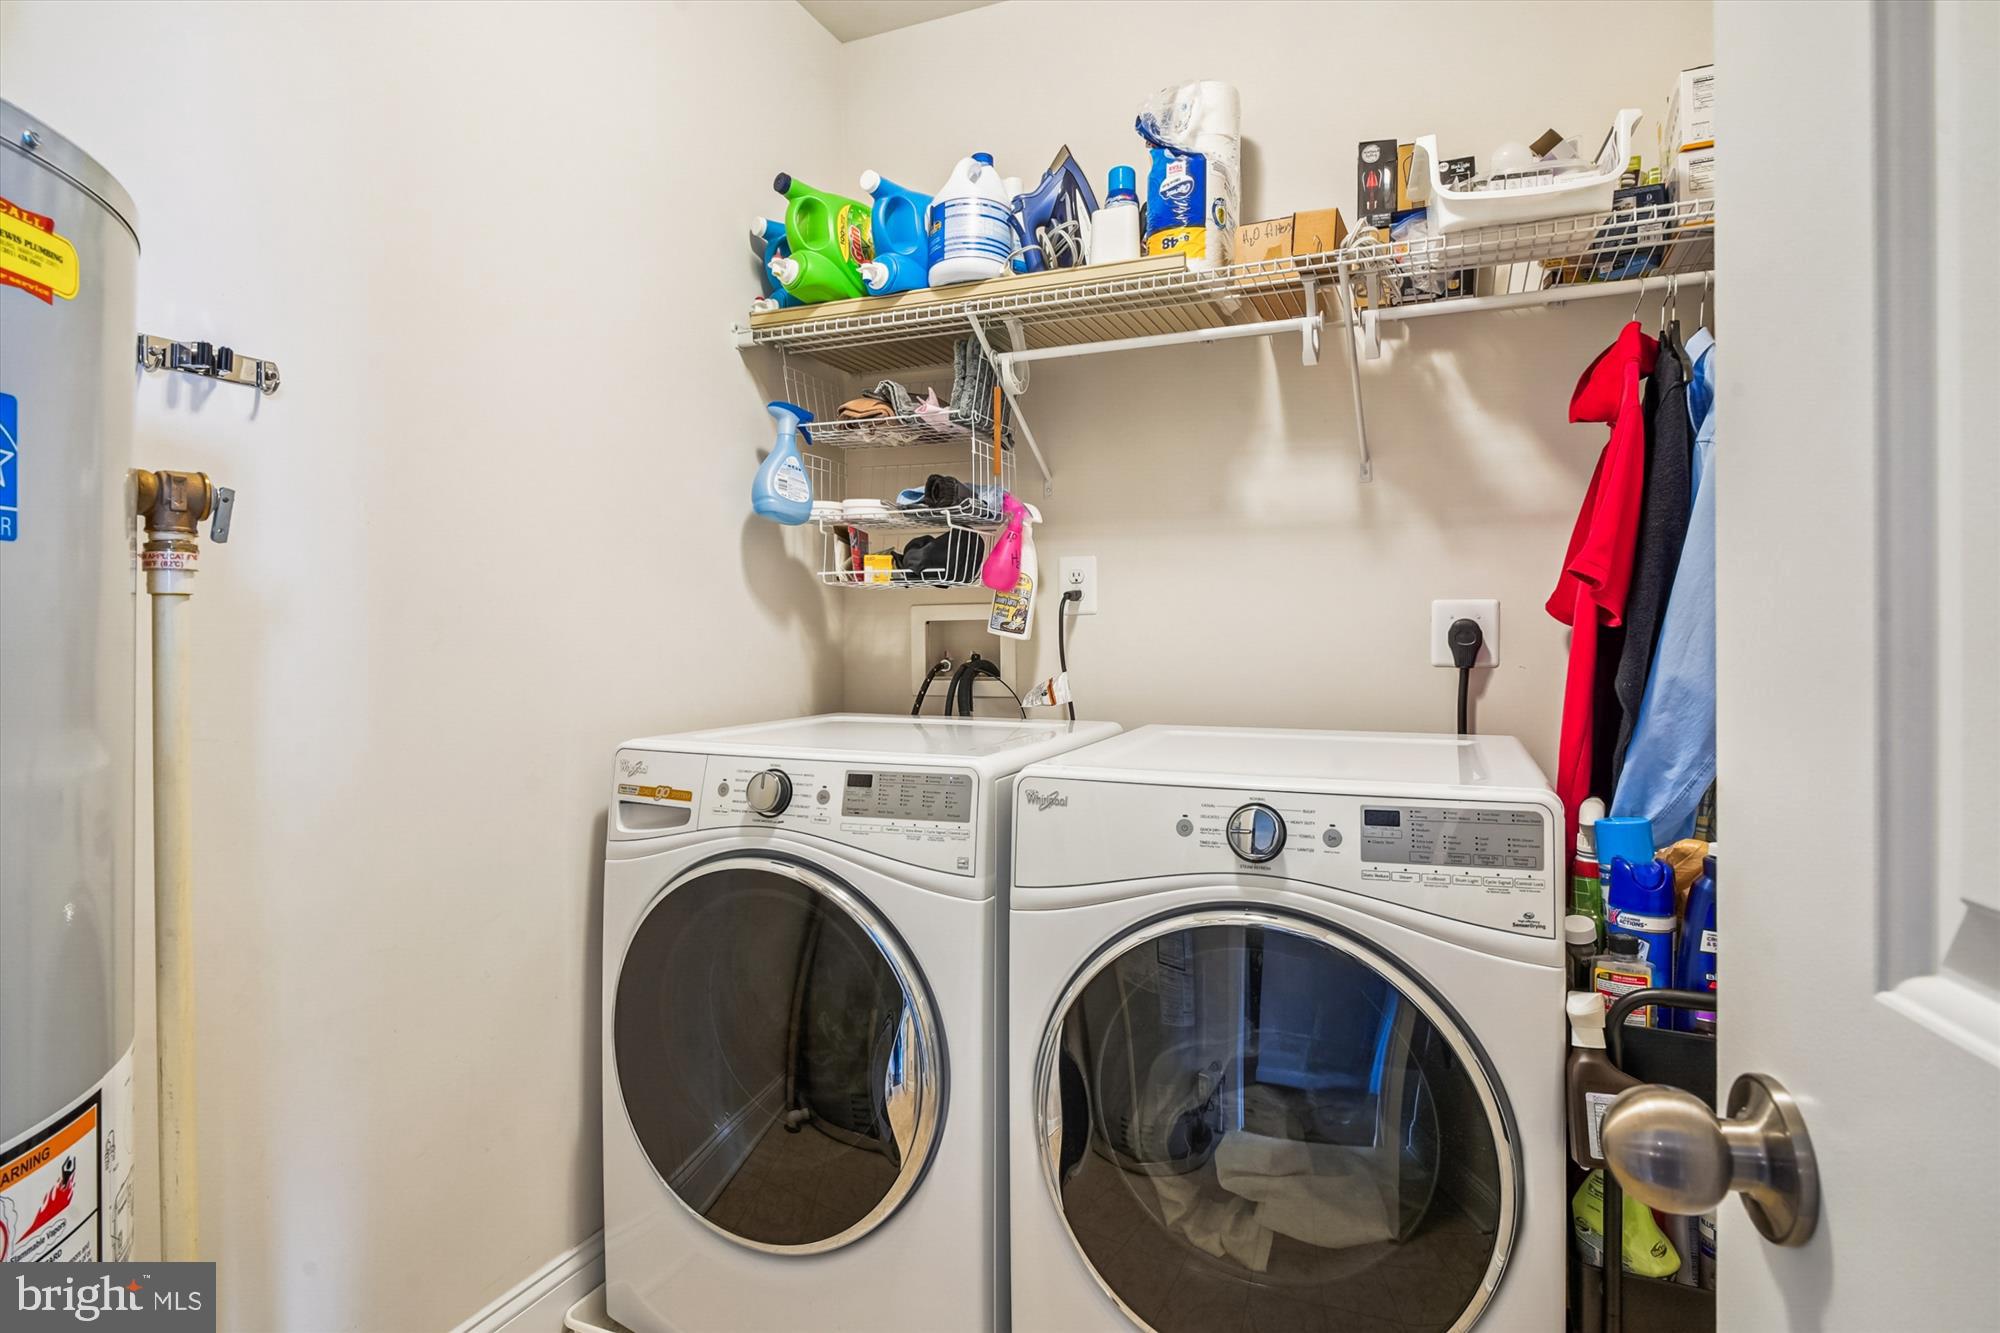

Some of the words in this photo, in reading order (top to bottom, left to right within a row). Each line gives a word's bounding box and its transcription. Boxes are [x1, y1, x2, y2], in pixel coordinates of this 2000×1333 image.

[24, 239, 64, 264] PLUMBING
[850, 226, 866, 264] Gain
[1162, 236, 1178, 250] 48
[1025, 790, 1069, 811] Whirlpool
